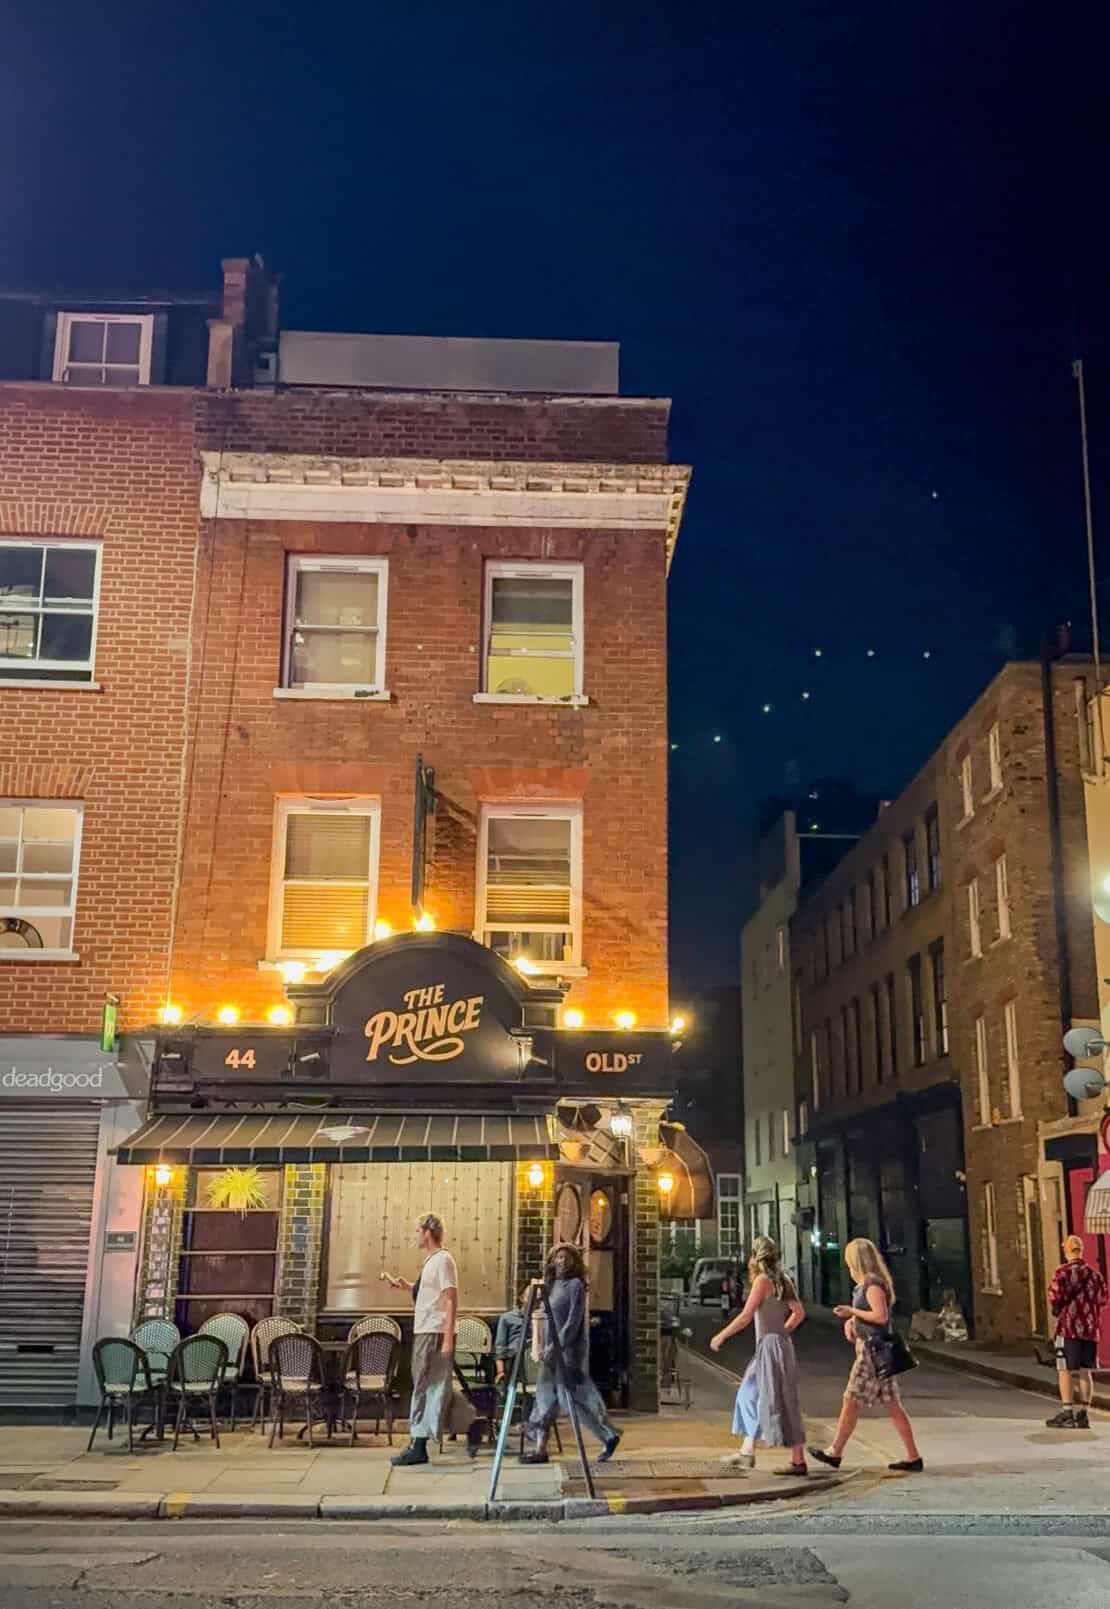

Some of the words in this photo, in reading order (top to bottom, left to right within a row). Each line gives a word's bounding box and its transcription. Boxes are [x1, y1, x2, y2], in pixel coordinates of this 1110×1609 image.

[403, 984, 445, 1010] THE
[364, 996, 484, 1064] PRINCE
[225, 1049, 257, 1070] 44
[2, 1066, 103, 1092] deadgood
